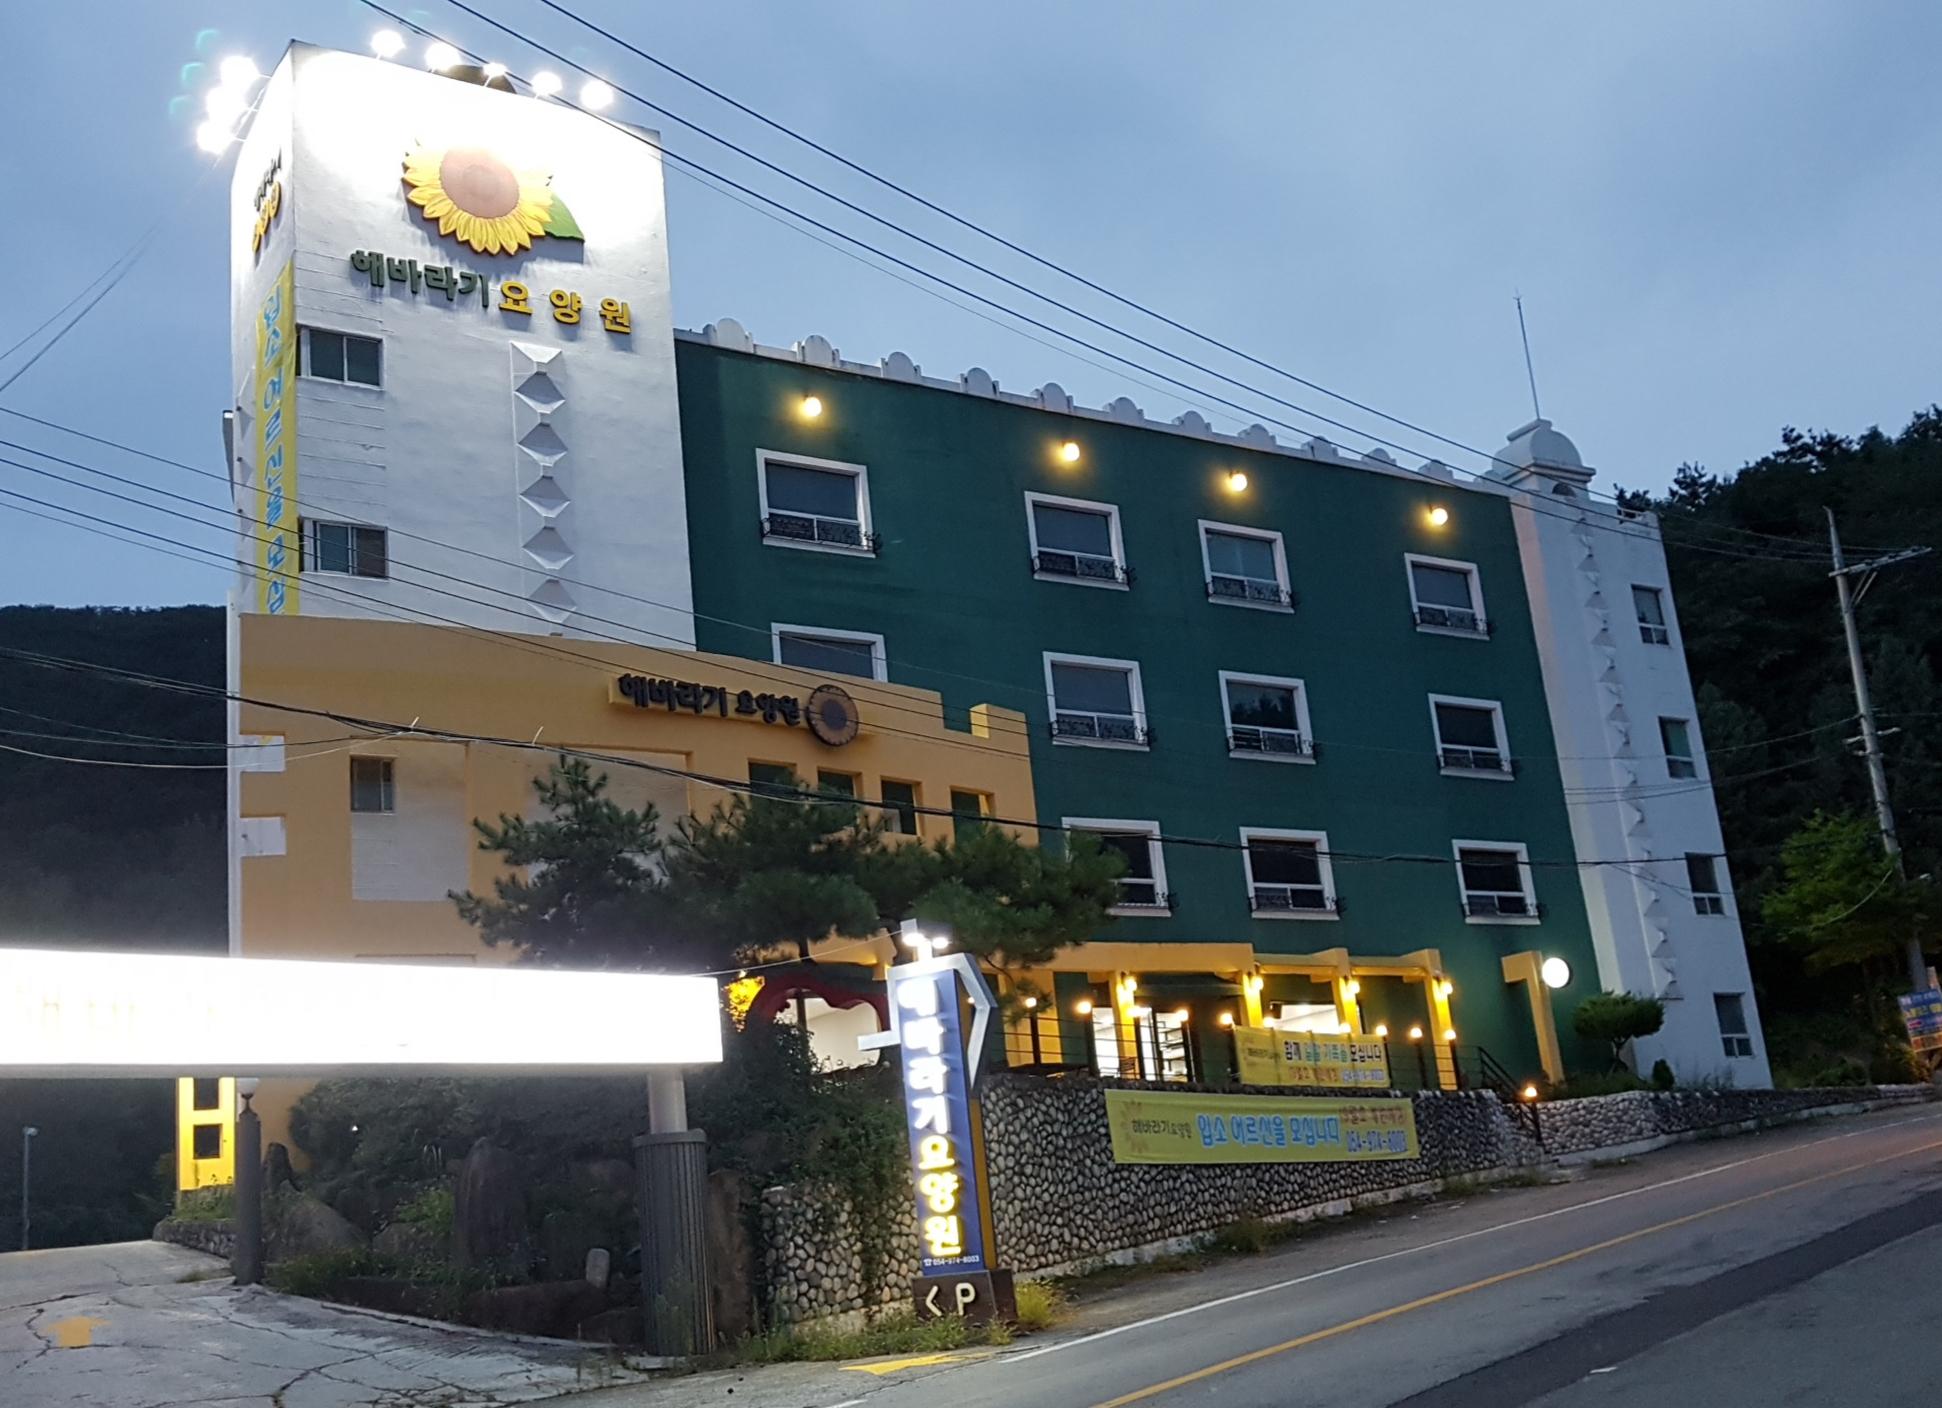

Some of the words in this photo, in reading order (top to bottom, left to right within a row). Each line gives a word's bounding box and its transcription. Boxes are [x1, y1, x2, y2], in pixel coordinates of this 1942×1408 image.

[350, 250, 489, 309] 해바라기
[499, 280, 632, 335] 요양원
[618, 673, 728, 718] 해바라기
[735, 690, 801, 726] 요양원
[1350, 1044, 1383, 1063] 모십니다
[1196, 1114, 1228, 1148] 입소
[1230, 1114, 1287, 1148] 어르신을
[1289, 1115, 1341, 1147] 모십니다
[918, 1135, 962, 1257] 요양원
[955, 1282, 976, 1316] P
